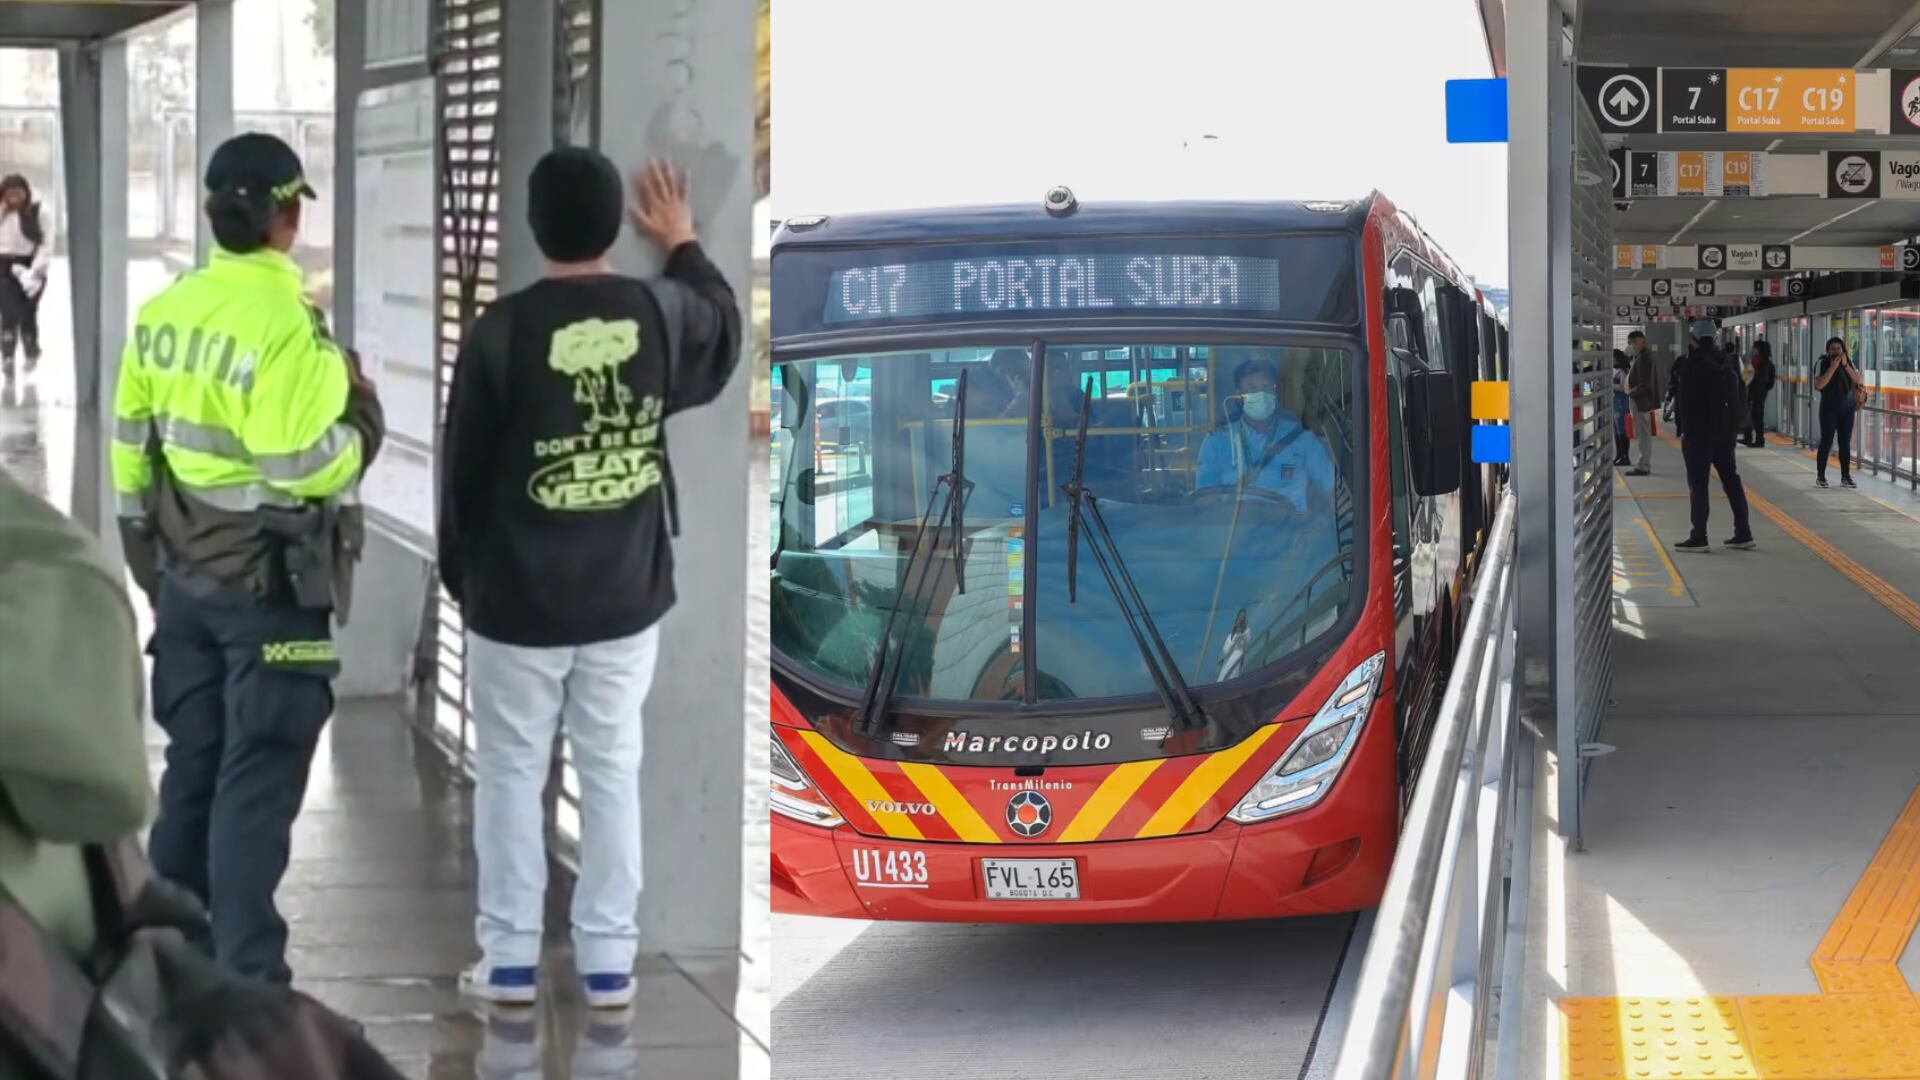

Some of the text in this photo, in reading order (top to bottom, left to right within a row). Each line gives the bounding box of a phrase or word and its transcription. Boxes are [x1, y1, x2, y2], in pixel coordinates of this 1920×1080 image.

[1687, 86, 1702, 111] 7
[1738, 86, 1780, 112] C17
[1802, 87, 1844, 112] C19
[1673, 115, 1717, 125] Portal Suba
[1737, 116, 1781, 125] Portal Suba
[1801, 116, 1845, 126] Portal Suba
[1640, 164, 1649, 177] 7
[1679, 164, 1701, 177] C17
[1725, 161, 1748, 175] C19
[843, 256, 1239, 314] C17 PORTAL SUBA
[135, 322, 257, 394] POICIA
[573, 450, 646, 480] EAT
[943, 731, 1111, 754] Marcopolo
[989, 779, 1073, 791] TransMilenio
[866, 800, 936, 816] VOLVO
[853, 849, 929, 883] U1433
